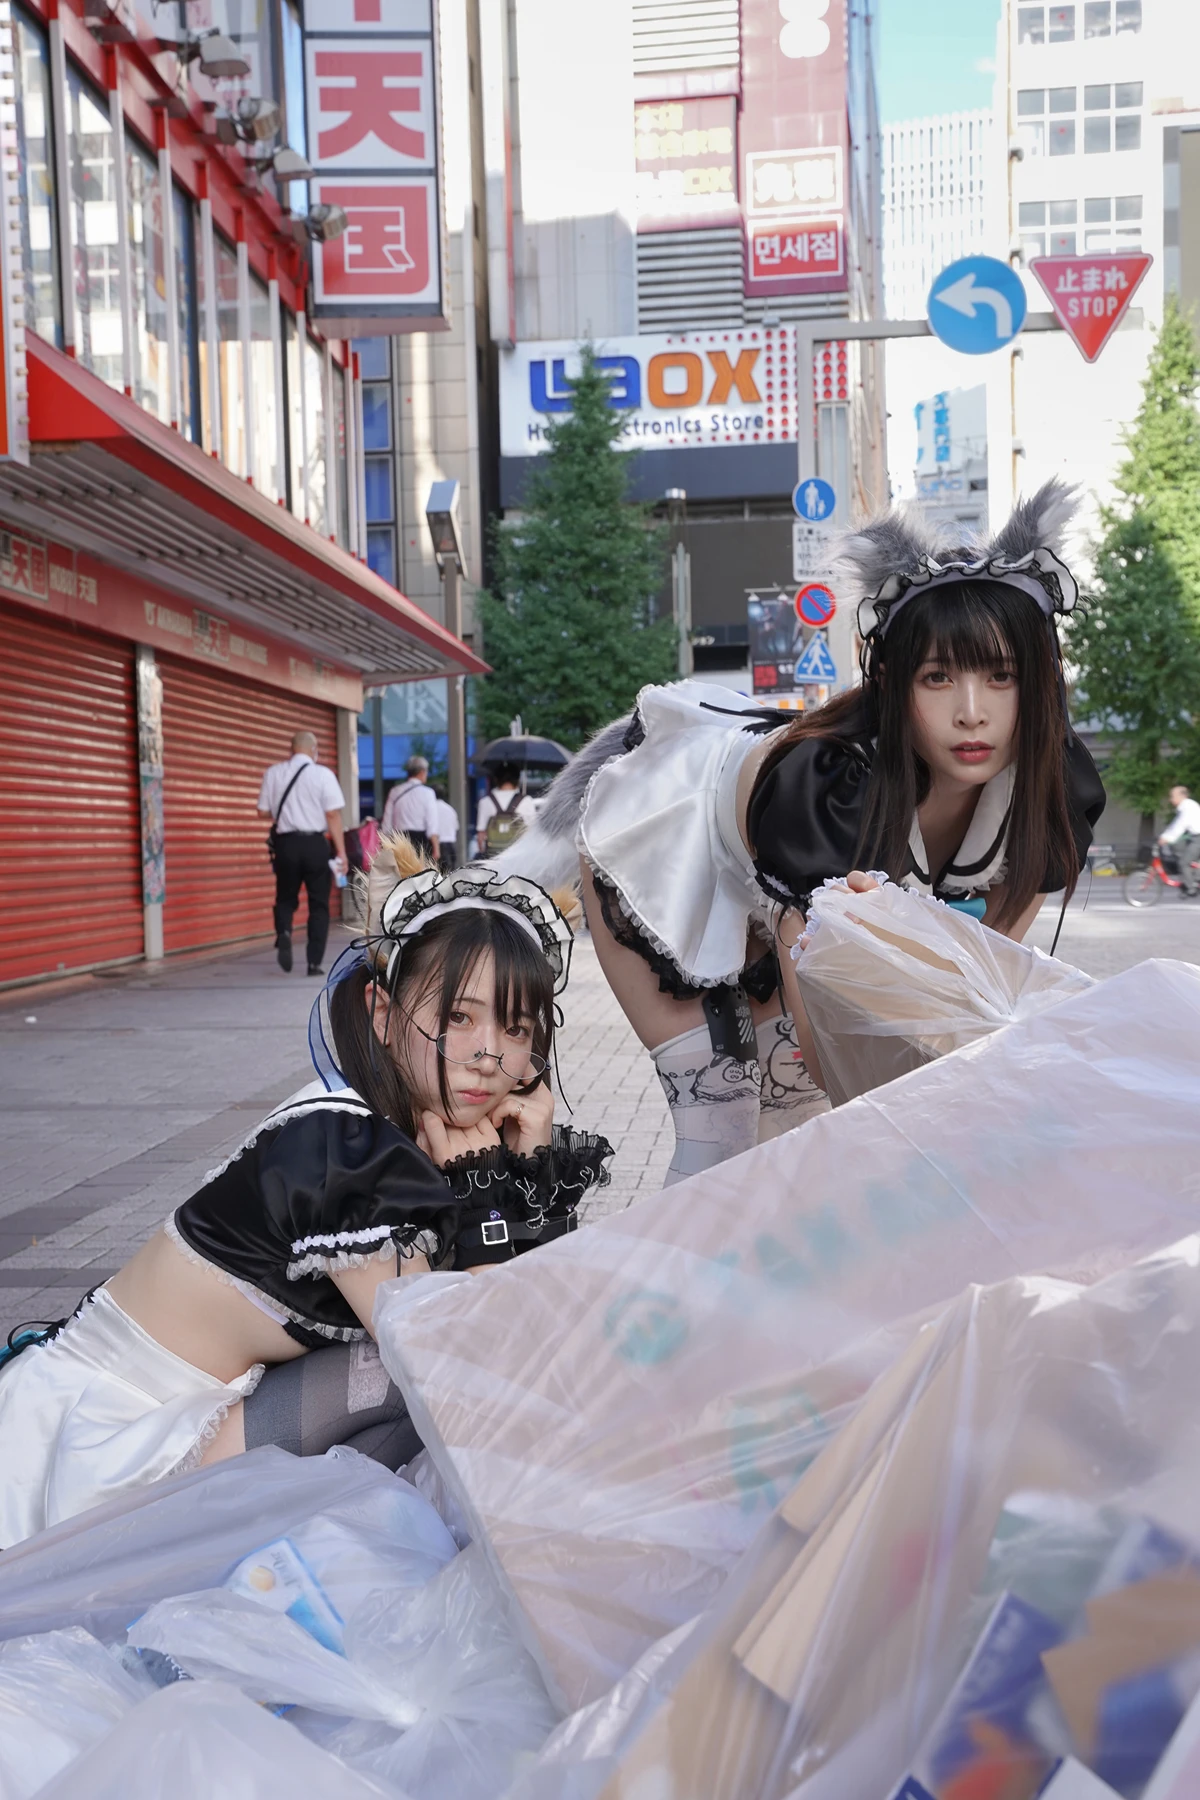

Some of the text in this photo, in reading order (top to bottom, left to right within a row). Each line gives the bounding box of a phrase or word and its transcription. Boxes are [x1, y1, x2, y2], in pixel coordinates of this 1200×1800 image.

[314, 0, 430, 295] 天国
[754, 230, 836, 266] 면세점
[1055, 265, 1129, 293] 止まれ
[1067, 296, 1119, 318] STOP
[711, 412, 764, 432] Store
